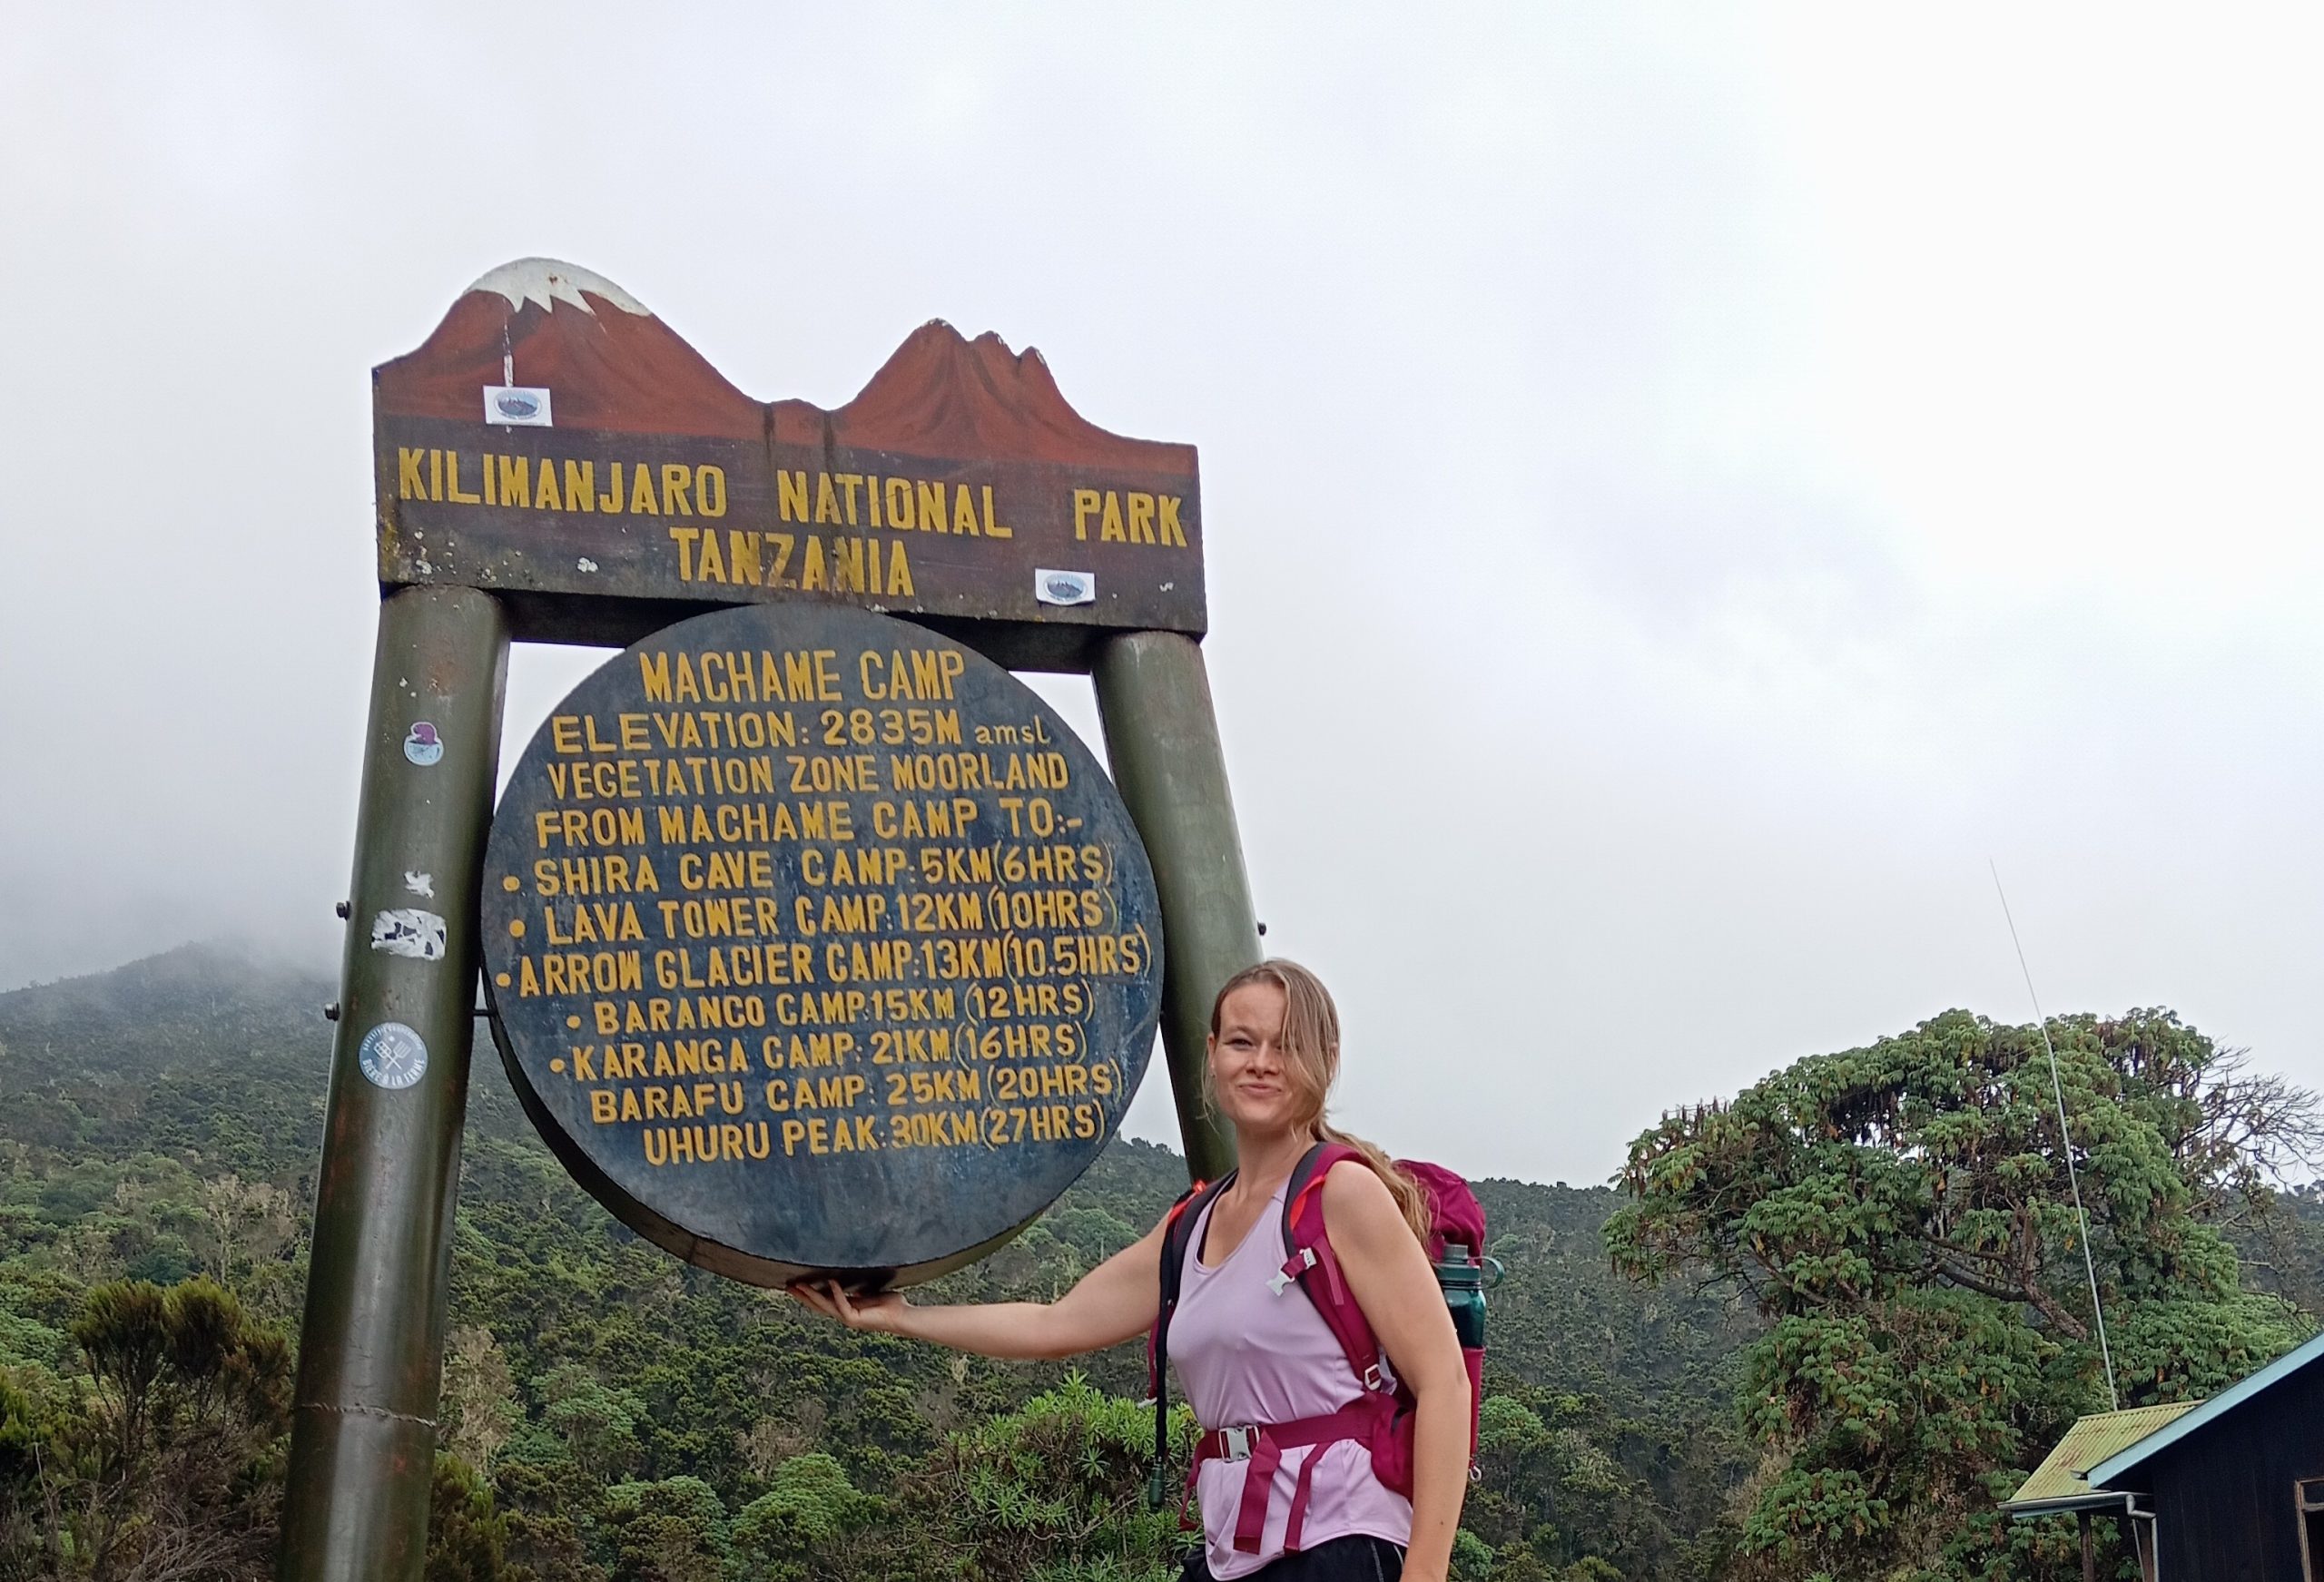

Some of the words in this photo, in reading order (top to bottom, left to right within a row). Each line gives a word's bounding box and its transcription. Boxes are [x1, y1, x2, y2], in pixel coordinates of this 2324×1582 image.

[399, 447, 727, 518] KILIMANJARO
[777, 469, 1012, 539] NATIONAL
[1073, 488, 1187, 547] PARK
[669, 526, 915, 596] TANZANIA
[639, 649, 842, 703] MACHAME
[859, 649, 965, 702] CAMP
[551, 711, 811, 753] ELEVATION:
[821, 708, 961, 746] 2835M
[974, 714, 1051, 745] amsl
[547, 755, 774, 800] VEGETATION
[786, 754, 880, 793] ZONE
[891, 752, 1069, 791] MOORLAND
[535, 805, 645, 849] FROM
[658, 800, 854, 844] MACHAME
[872, 798, 978, 840] CAMP
[534, 854, 660, 897] SHIRA
[679, 850, 773, 890] CAVE
[545, 900, 645, 946] LAVA
[657, 895, 780, 939] TOWER
[519, 949, 643, 997] ARROW
[655, 942, 815, 990] GLACIER
[593, 994, 765, 1036] BARANCO
[573, 1037, 749, 1082] KARANGA
[590, 1080, 744, 1125] BARAFU
[643, 1120, 770, 1166] UHURU
